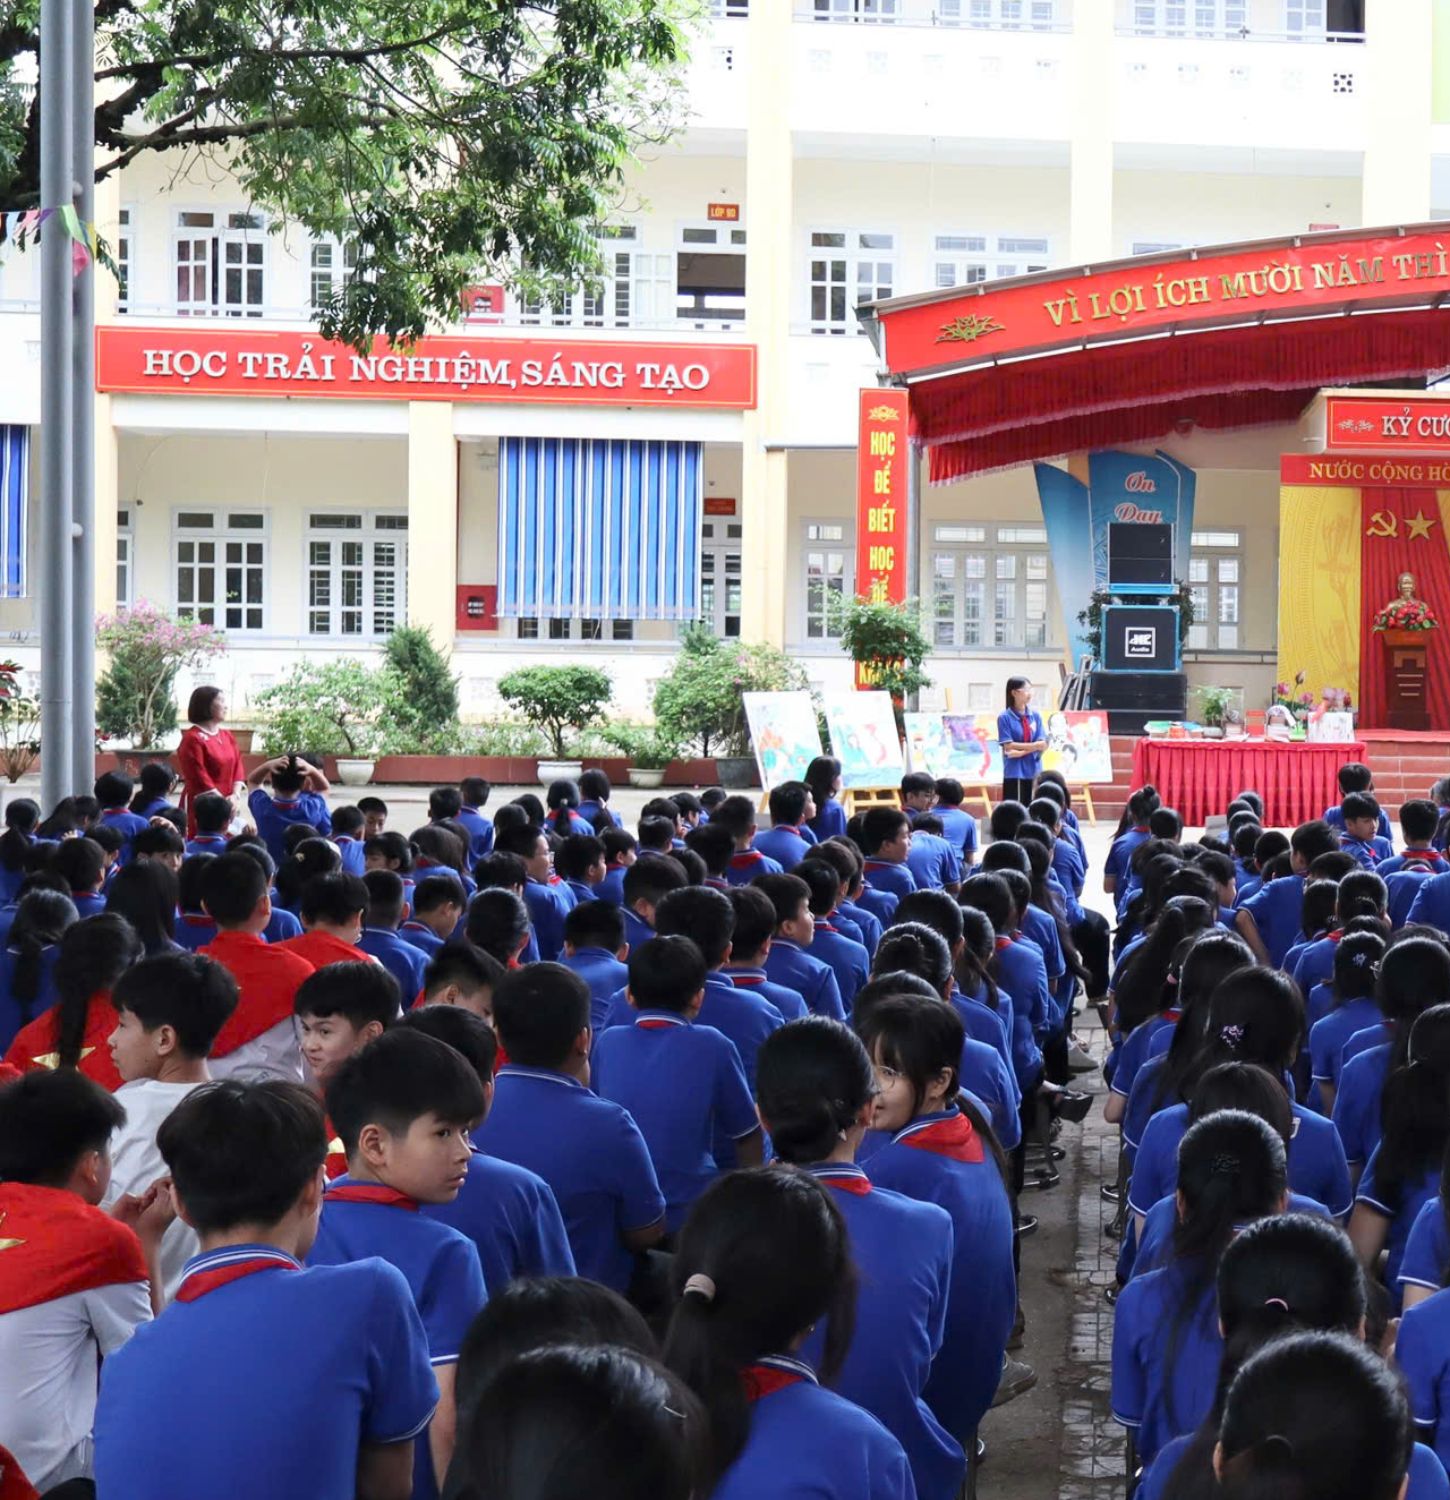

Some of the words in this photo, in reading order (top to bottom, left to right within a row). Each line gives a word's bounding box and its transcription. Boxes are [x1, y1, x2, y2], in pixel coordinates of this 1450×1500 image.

[1044, 289, 1081, 326] VÌ
[1089, 284, 1147, 322] LỢI
[1153, 273, 1212, 309] ÍCH
[1219, 260, 1304, 301] MƯỜI
[1311, 255, 1384, 290] NĂM
[1392, 242, 1448, 280] THÌ
[143, 349, 227, 384] HỌC
[238, 343, 336, 381] TRẢI
[636, 363, 711, 395] TẠO
[1381, 407, 1413, 436] KỶ
[870, 431, 895, 462] HỌC
[874, 459, 892, 494] ĐỂ
[1309, 459, 1365, 480] NƯỚC
[1369, 460, 1424, 484] CỘNG
[868, 499, 895, 533] BIẾT
[869, 546, 895, 576] HỌC
